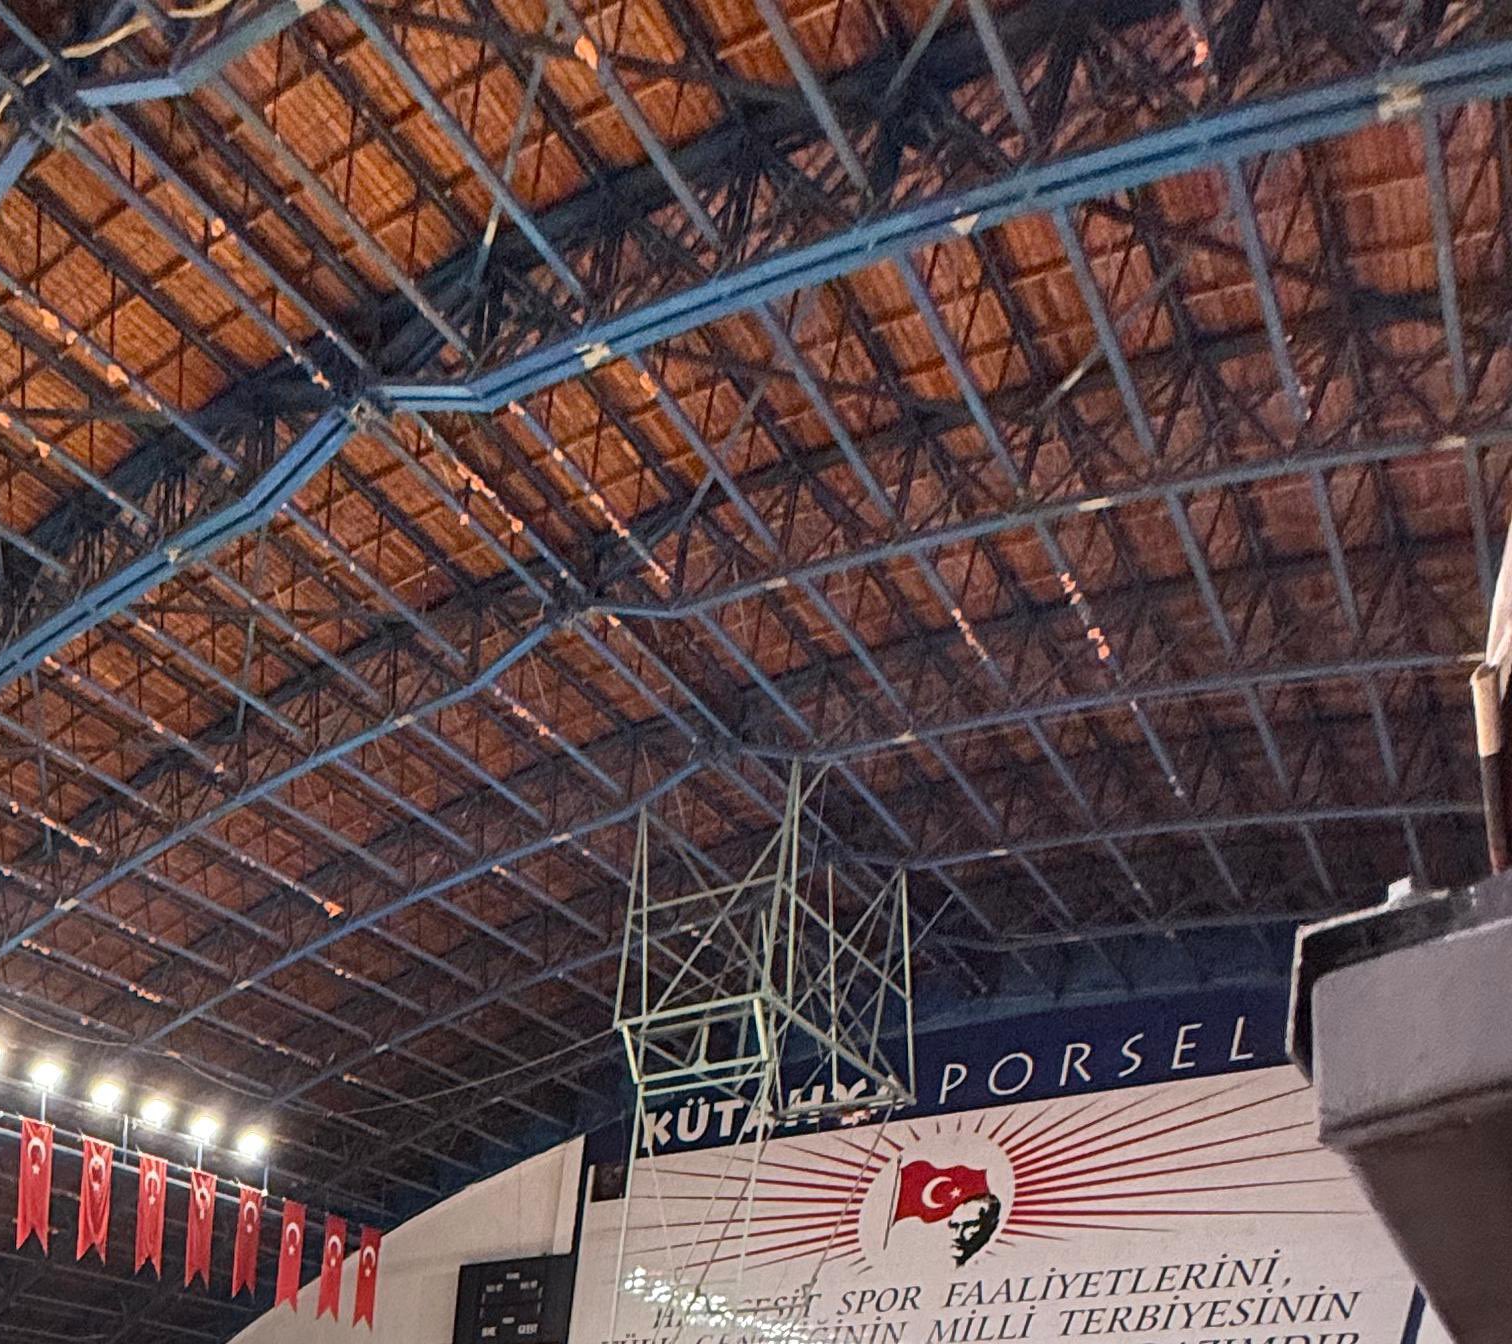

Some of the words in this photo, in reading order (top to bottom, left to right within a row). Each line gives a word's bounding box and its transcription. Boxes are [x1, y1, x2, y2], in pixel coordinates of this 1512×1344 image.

[836, 1284, 922, 1316] SPOR
[926, 1304, 1037, 1343] MİLLİ
[1057, 1284, 1362, 1337] TERBİYESİNİN
